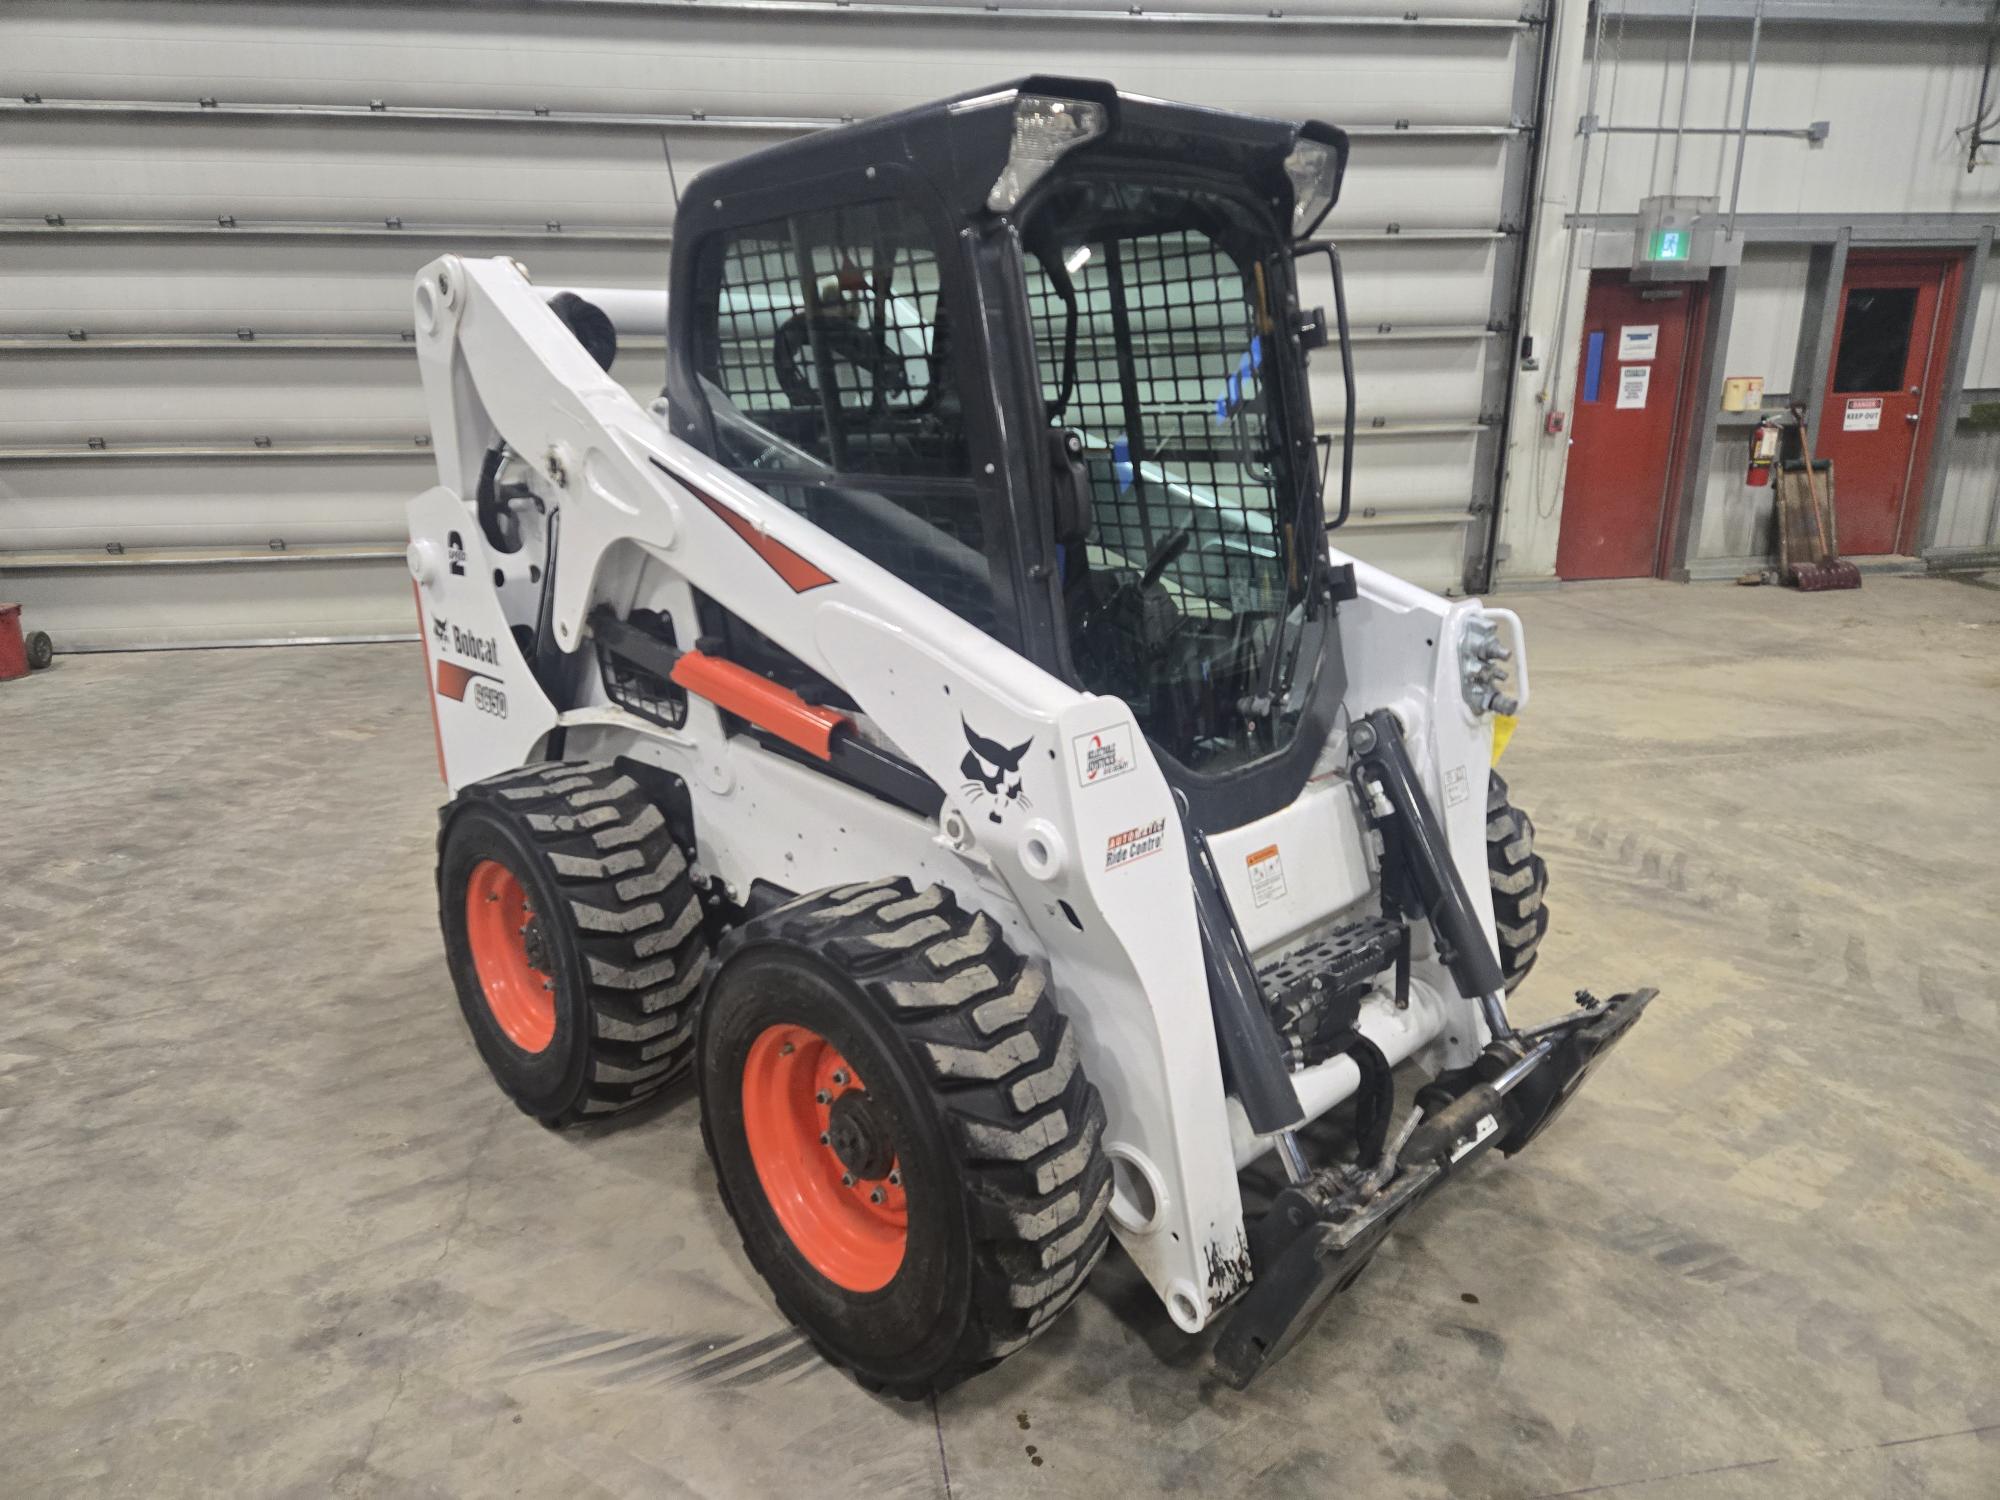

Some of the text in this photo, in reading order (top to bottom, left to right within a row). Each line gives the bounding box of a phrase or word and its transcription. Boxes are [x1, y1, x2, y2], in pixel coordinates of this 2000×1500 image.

[1846, 412, 1878, 420] KEEP OUT
[452, 624, 500, 667] Bobcat
[1105, 832, 1165, 868] Ride Control
